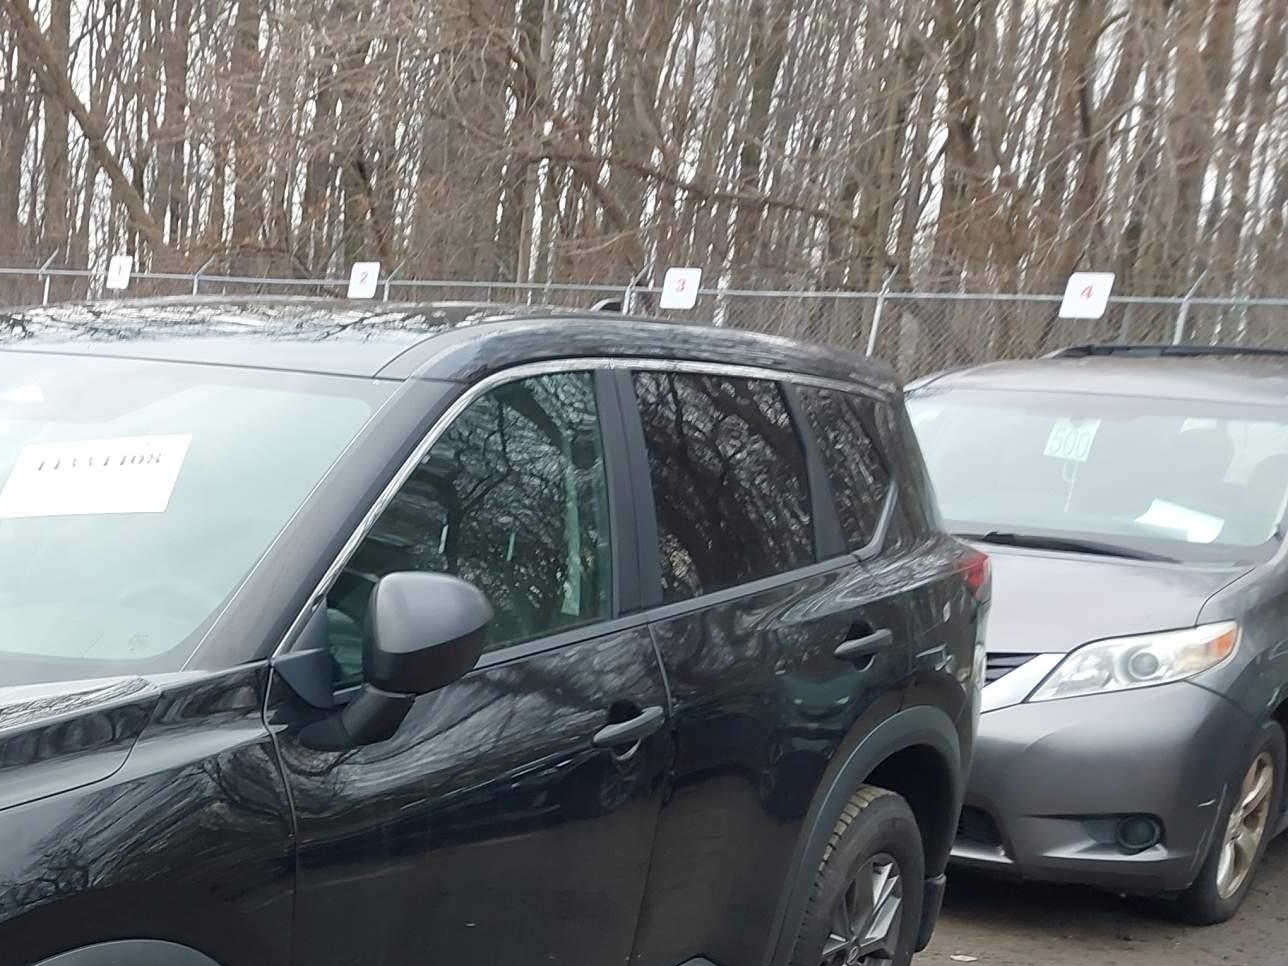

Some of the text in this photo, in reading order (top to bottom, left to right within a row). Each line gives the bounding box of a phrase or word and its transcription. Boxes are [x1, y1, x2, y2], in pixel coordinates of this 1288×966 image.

[359, 271, 369, 285] 2
[674, 278, 687, 293] 3
[1079, 285, 1093, 300] 4
